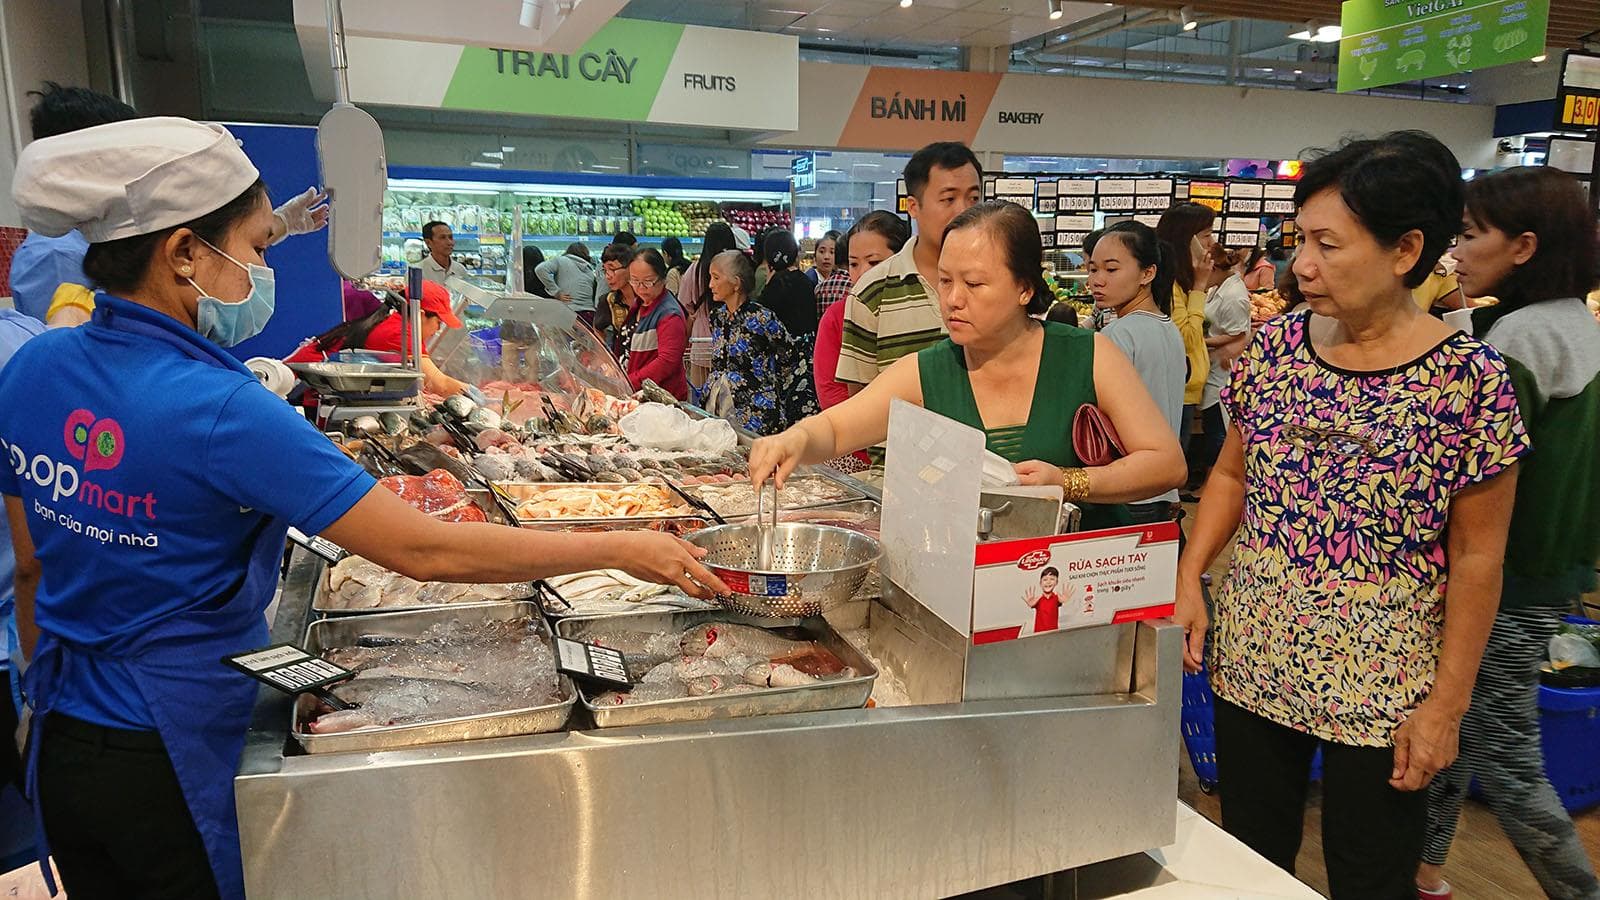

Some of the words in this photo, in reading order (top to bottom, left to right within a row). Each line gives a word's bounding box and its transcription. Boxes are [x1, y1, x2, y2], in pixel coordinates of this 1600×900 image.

[578, 48, 638, 84] CÂY
[684, 73, 735, 91] FRUITS
[871, 91, 936, 121] BÁNH
[941, 94, 966, 122] MÌ
[998, 111, 1044, 124] BAKERY
[34, 498, 56, 520] bạn
[58, 514, 82, 534] của
[85, 525, 114, 545] mọi
[118, 532, 158, 547] nhà
[1095, 555, 1125, 568] SẠCH
[1128, 552, 1148, 563] TAY
